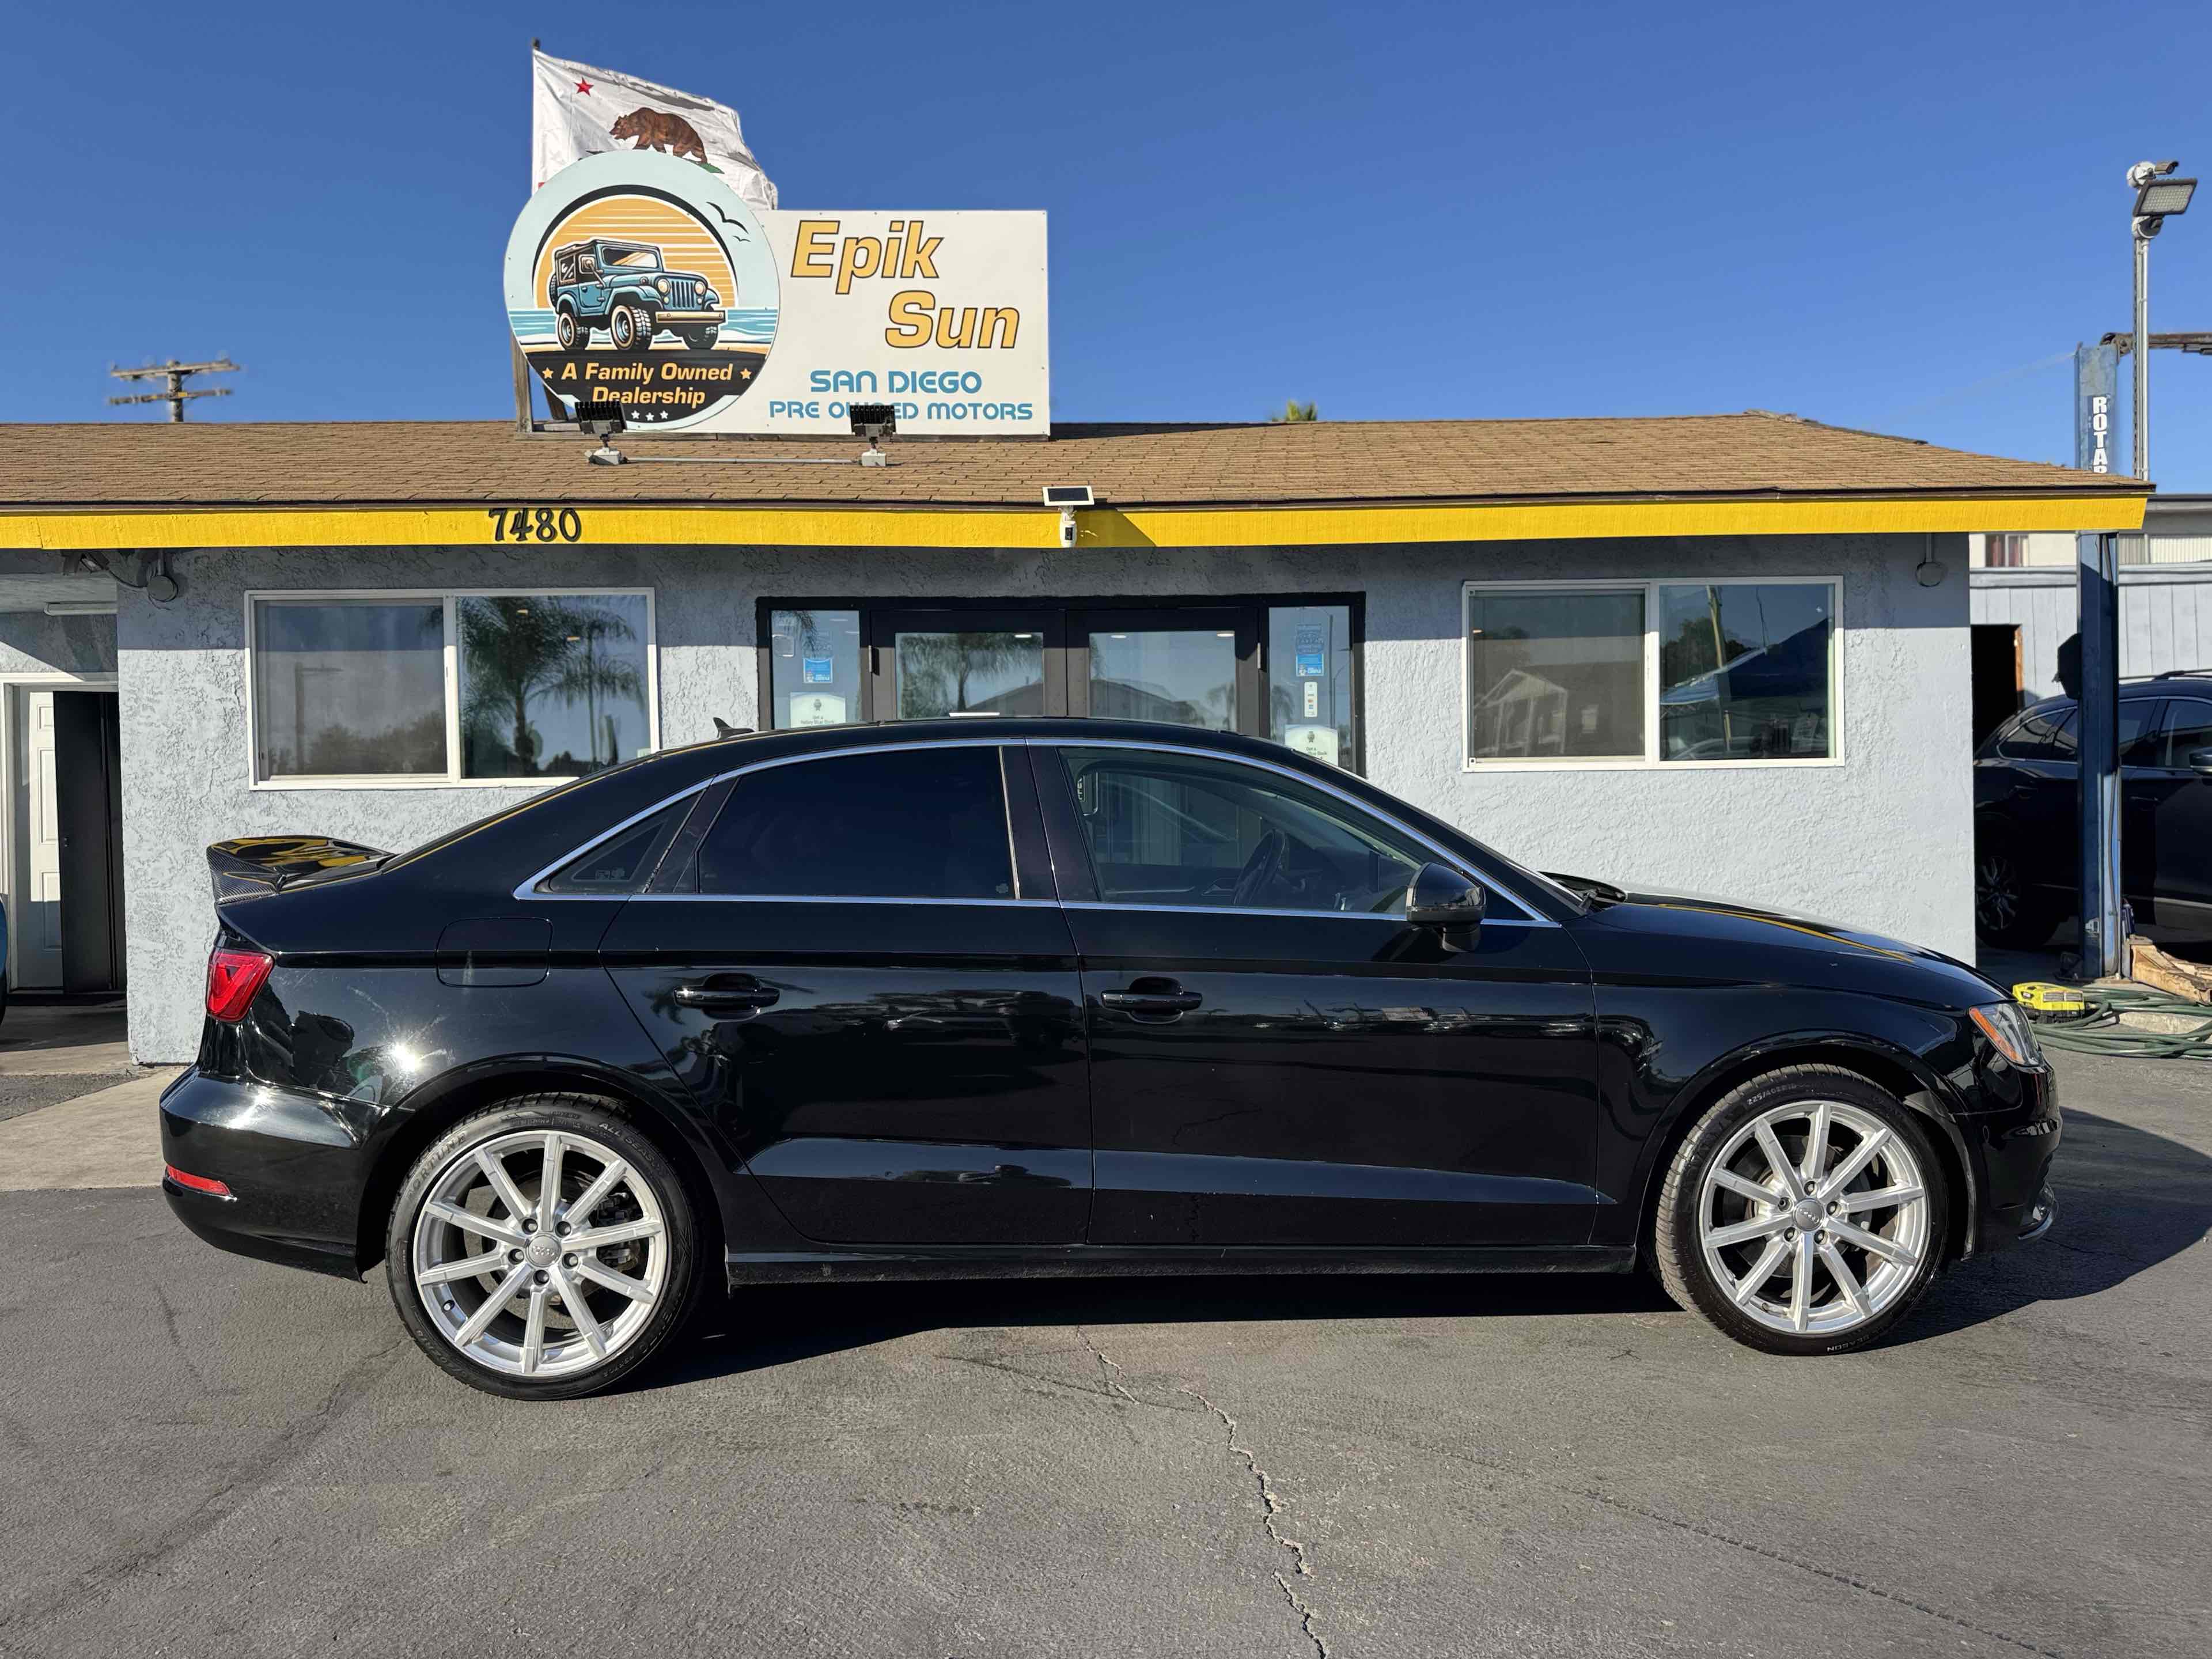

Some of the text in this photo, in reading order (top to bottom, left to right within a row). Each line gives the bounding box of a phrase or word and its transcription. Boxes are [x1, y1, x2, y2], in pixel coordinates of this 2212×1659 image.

[790, 220, 945, 295] Epik
[885, 290, 1020, 349] Sun
[561, 362, 733, 385] A Family Owned
[810, 370, 982, 393] SAN DIEGO
[592, 386, 706, 408] Dealership
[770, 401, 1033, 420] PRE OED MOTORS
[488, 507, 582, 542] 7480
[599, 1123, 621, 1137] ALL
[408, 1131, 467, 1198] FORTUNE
